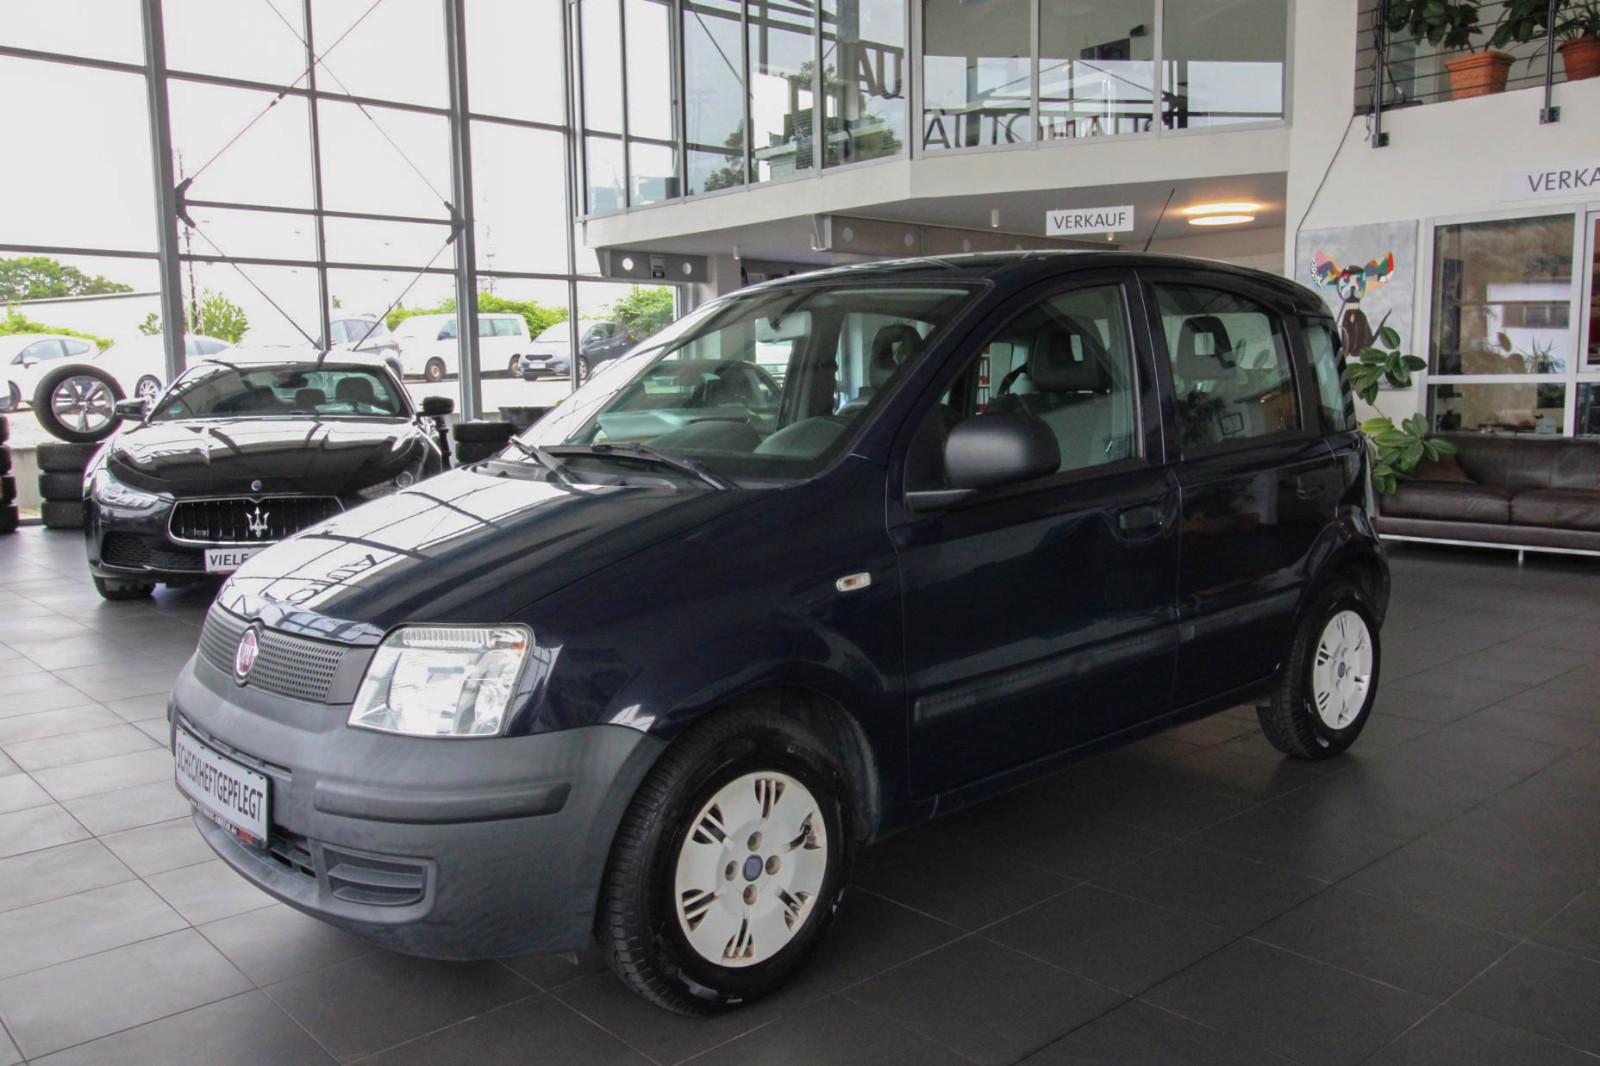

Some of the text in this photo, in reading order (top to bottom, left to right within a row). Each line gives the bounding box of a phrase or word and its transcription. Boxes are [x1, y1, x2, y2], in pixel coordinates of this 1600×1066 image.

[1528, 167, 1600, 193] VERKA
[1054, 212, 1127, 229] VERKAUF
[177, 743, 263, 822] SCHECKHEFTGEPFLEGT
